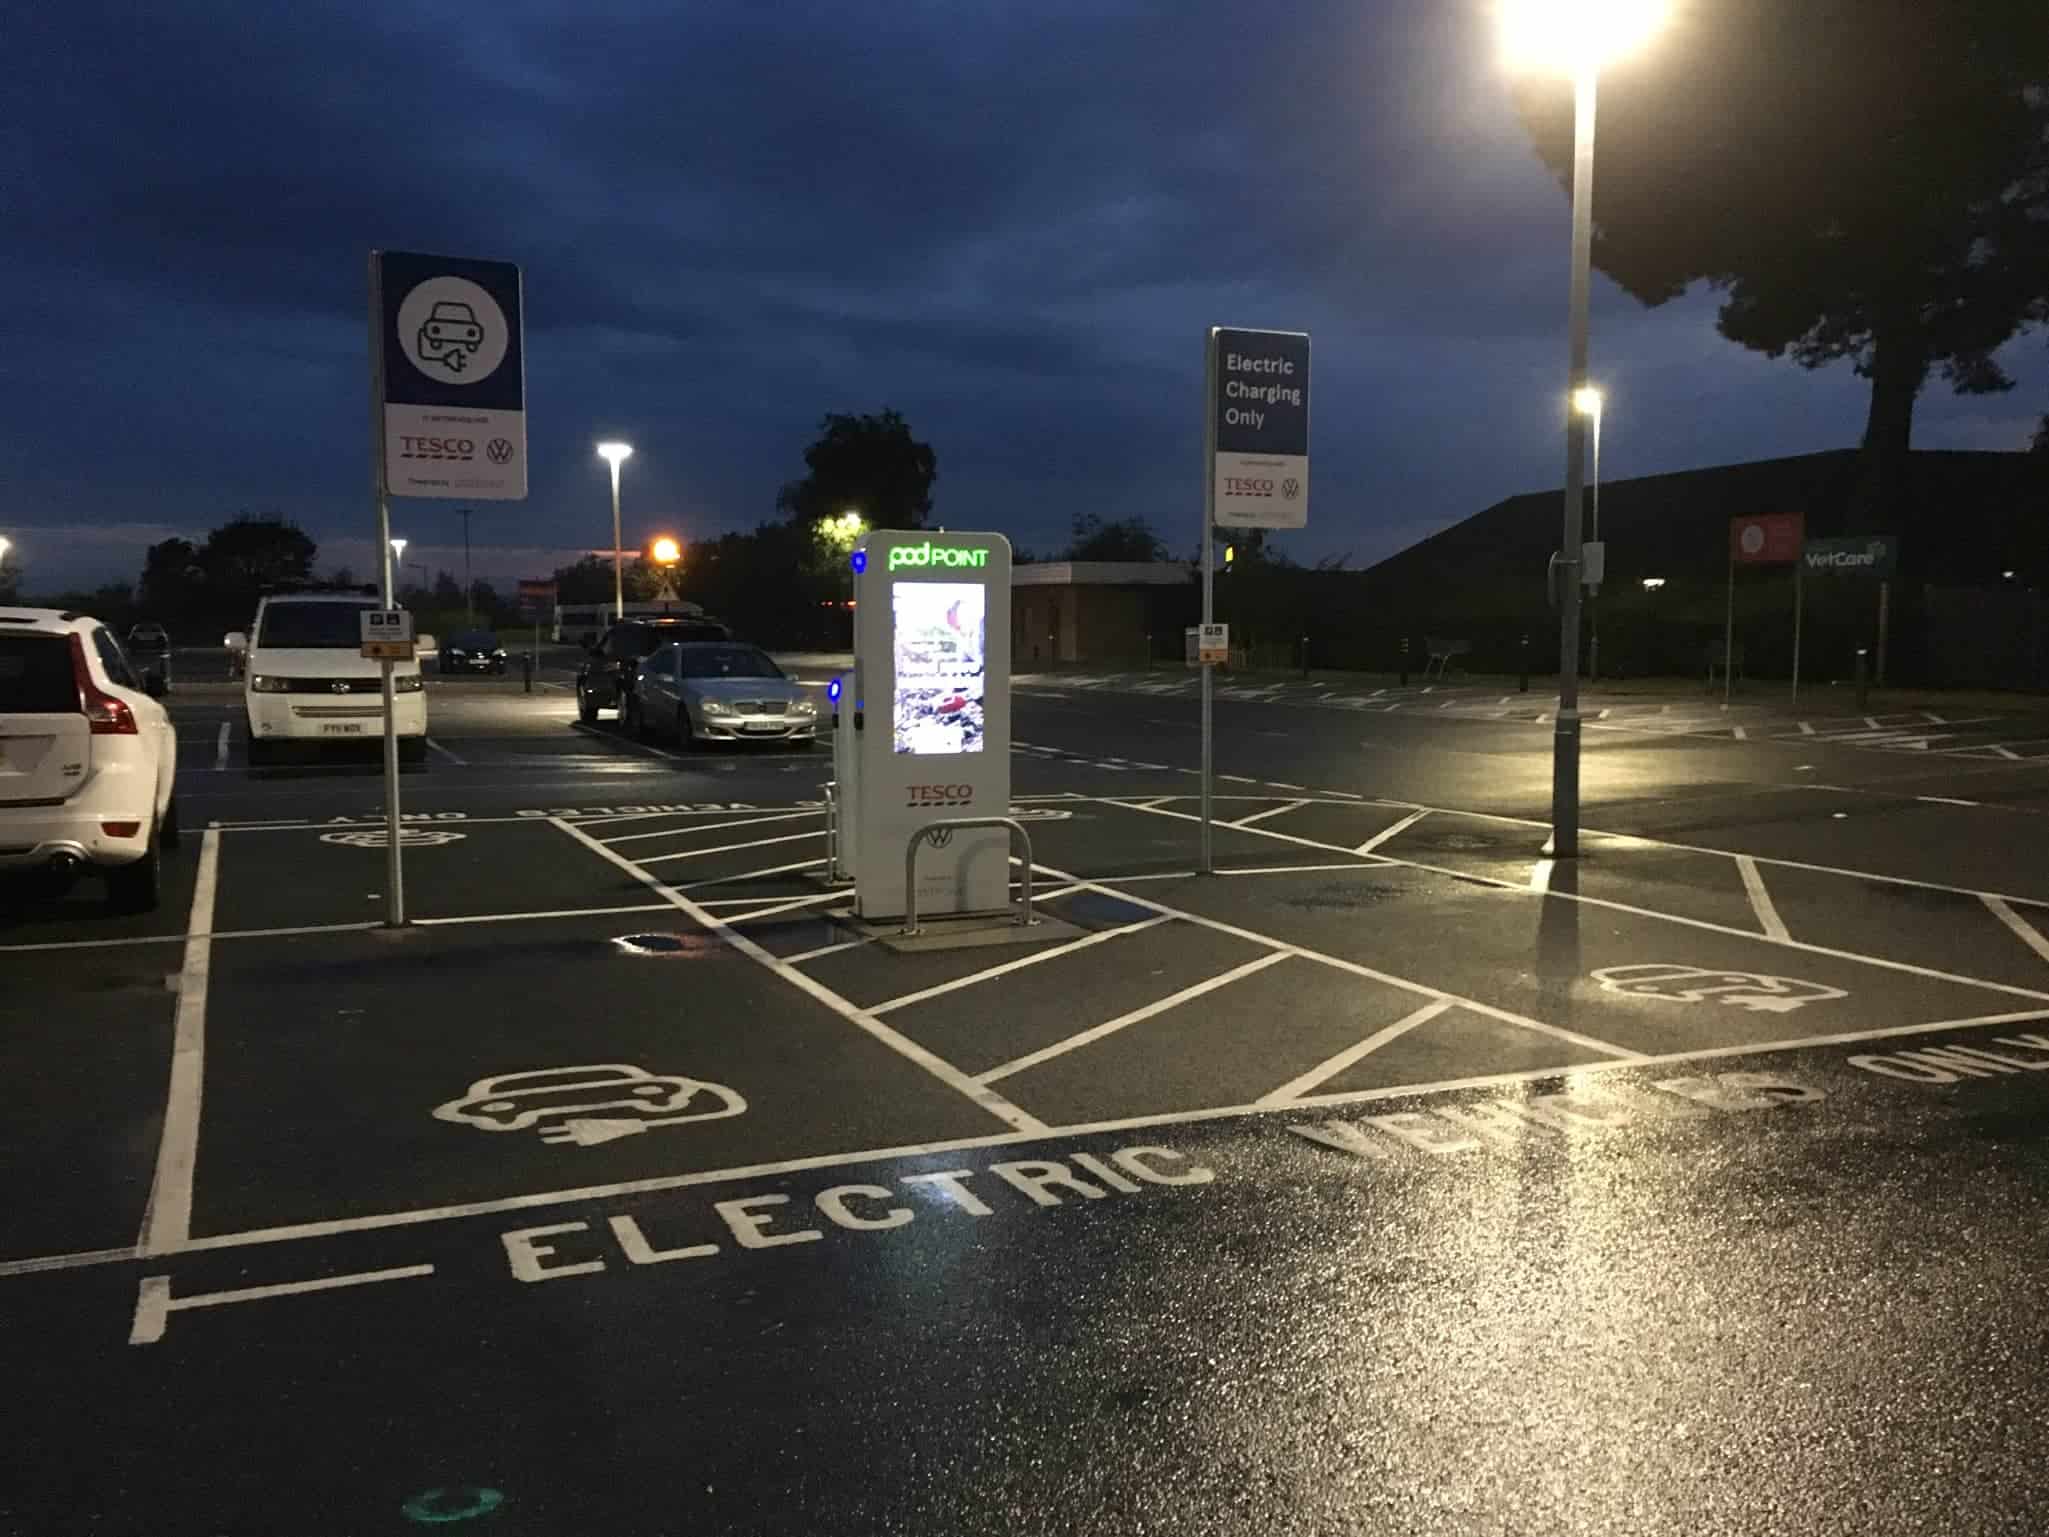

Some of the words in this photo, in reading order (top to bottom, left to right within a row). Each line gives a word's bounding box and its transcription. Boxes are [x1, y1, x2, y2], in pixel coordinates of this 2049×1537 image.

[1226, 353, 1295, 375] Electric
[1225, 380, 1301, 406] Charging
[1225, 407, 1265, 431] Only
[400, 435, 475, 454] TESCO
[1223, 477, 1274, 492] TESCO
[905, 784, 974, 801] TESCO
[501, 1145, 1215, 1283] ELECTRIC
